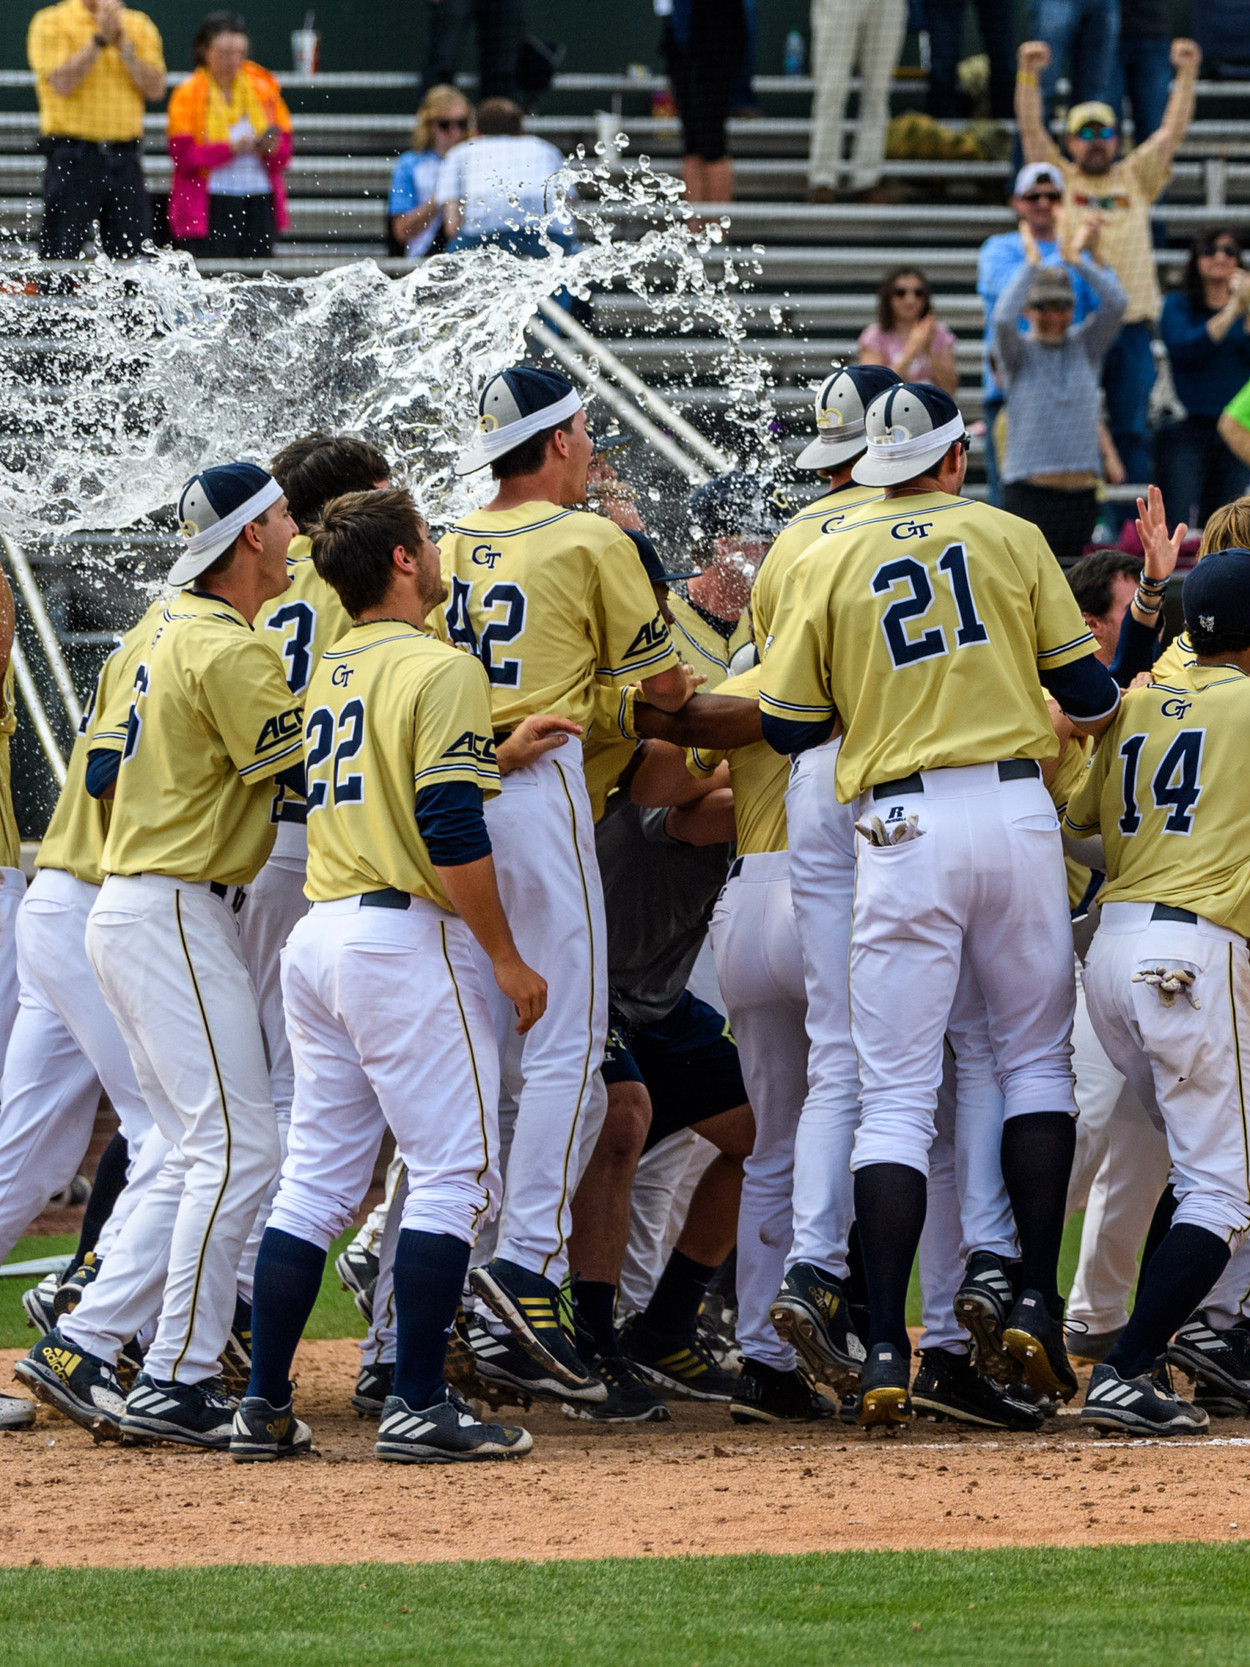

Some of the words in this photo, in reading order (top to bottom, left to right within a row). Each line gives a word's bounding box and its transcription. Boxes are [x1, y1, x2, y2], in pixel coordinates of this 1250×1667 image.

[471, 544, 501, 569] GT
[890, 520, 933, 540] GT
[445, 573, 528, 689] 42
[869, 541, 991, 670] 21
[331, 663, 354, 688] GT
[1160, 697, 1193, 721] GT
[305, 696, 365, 819] 22
[1117, 727, 1207, 837] 14
